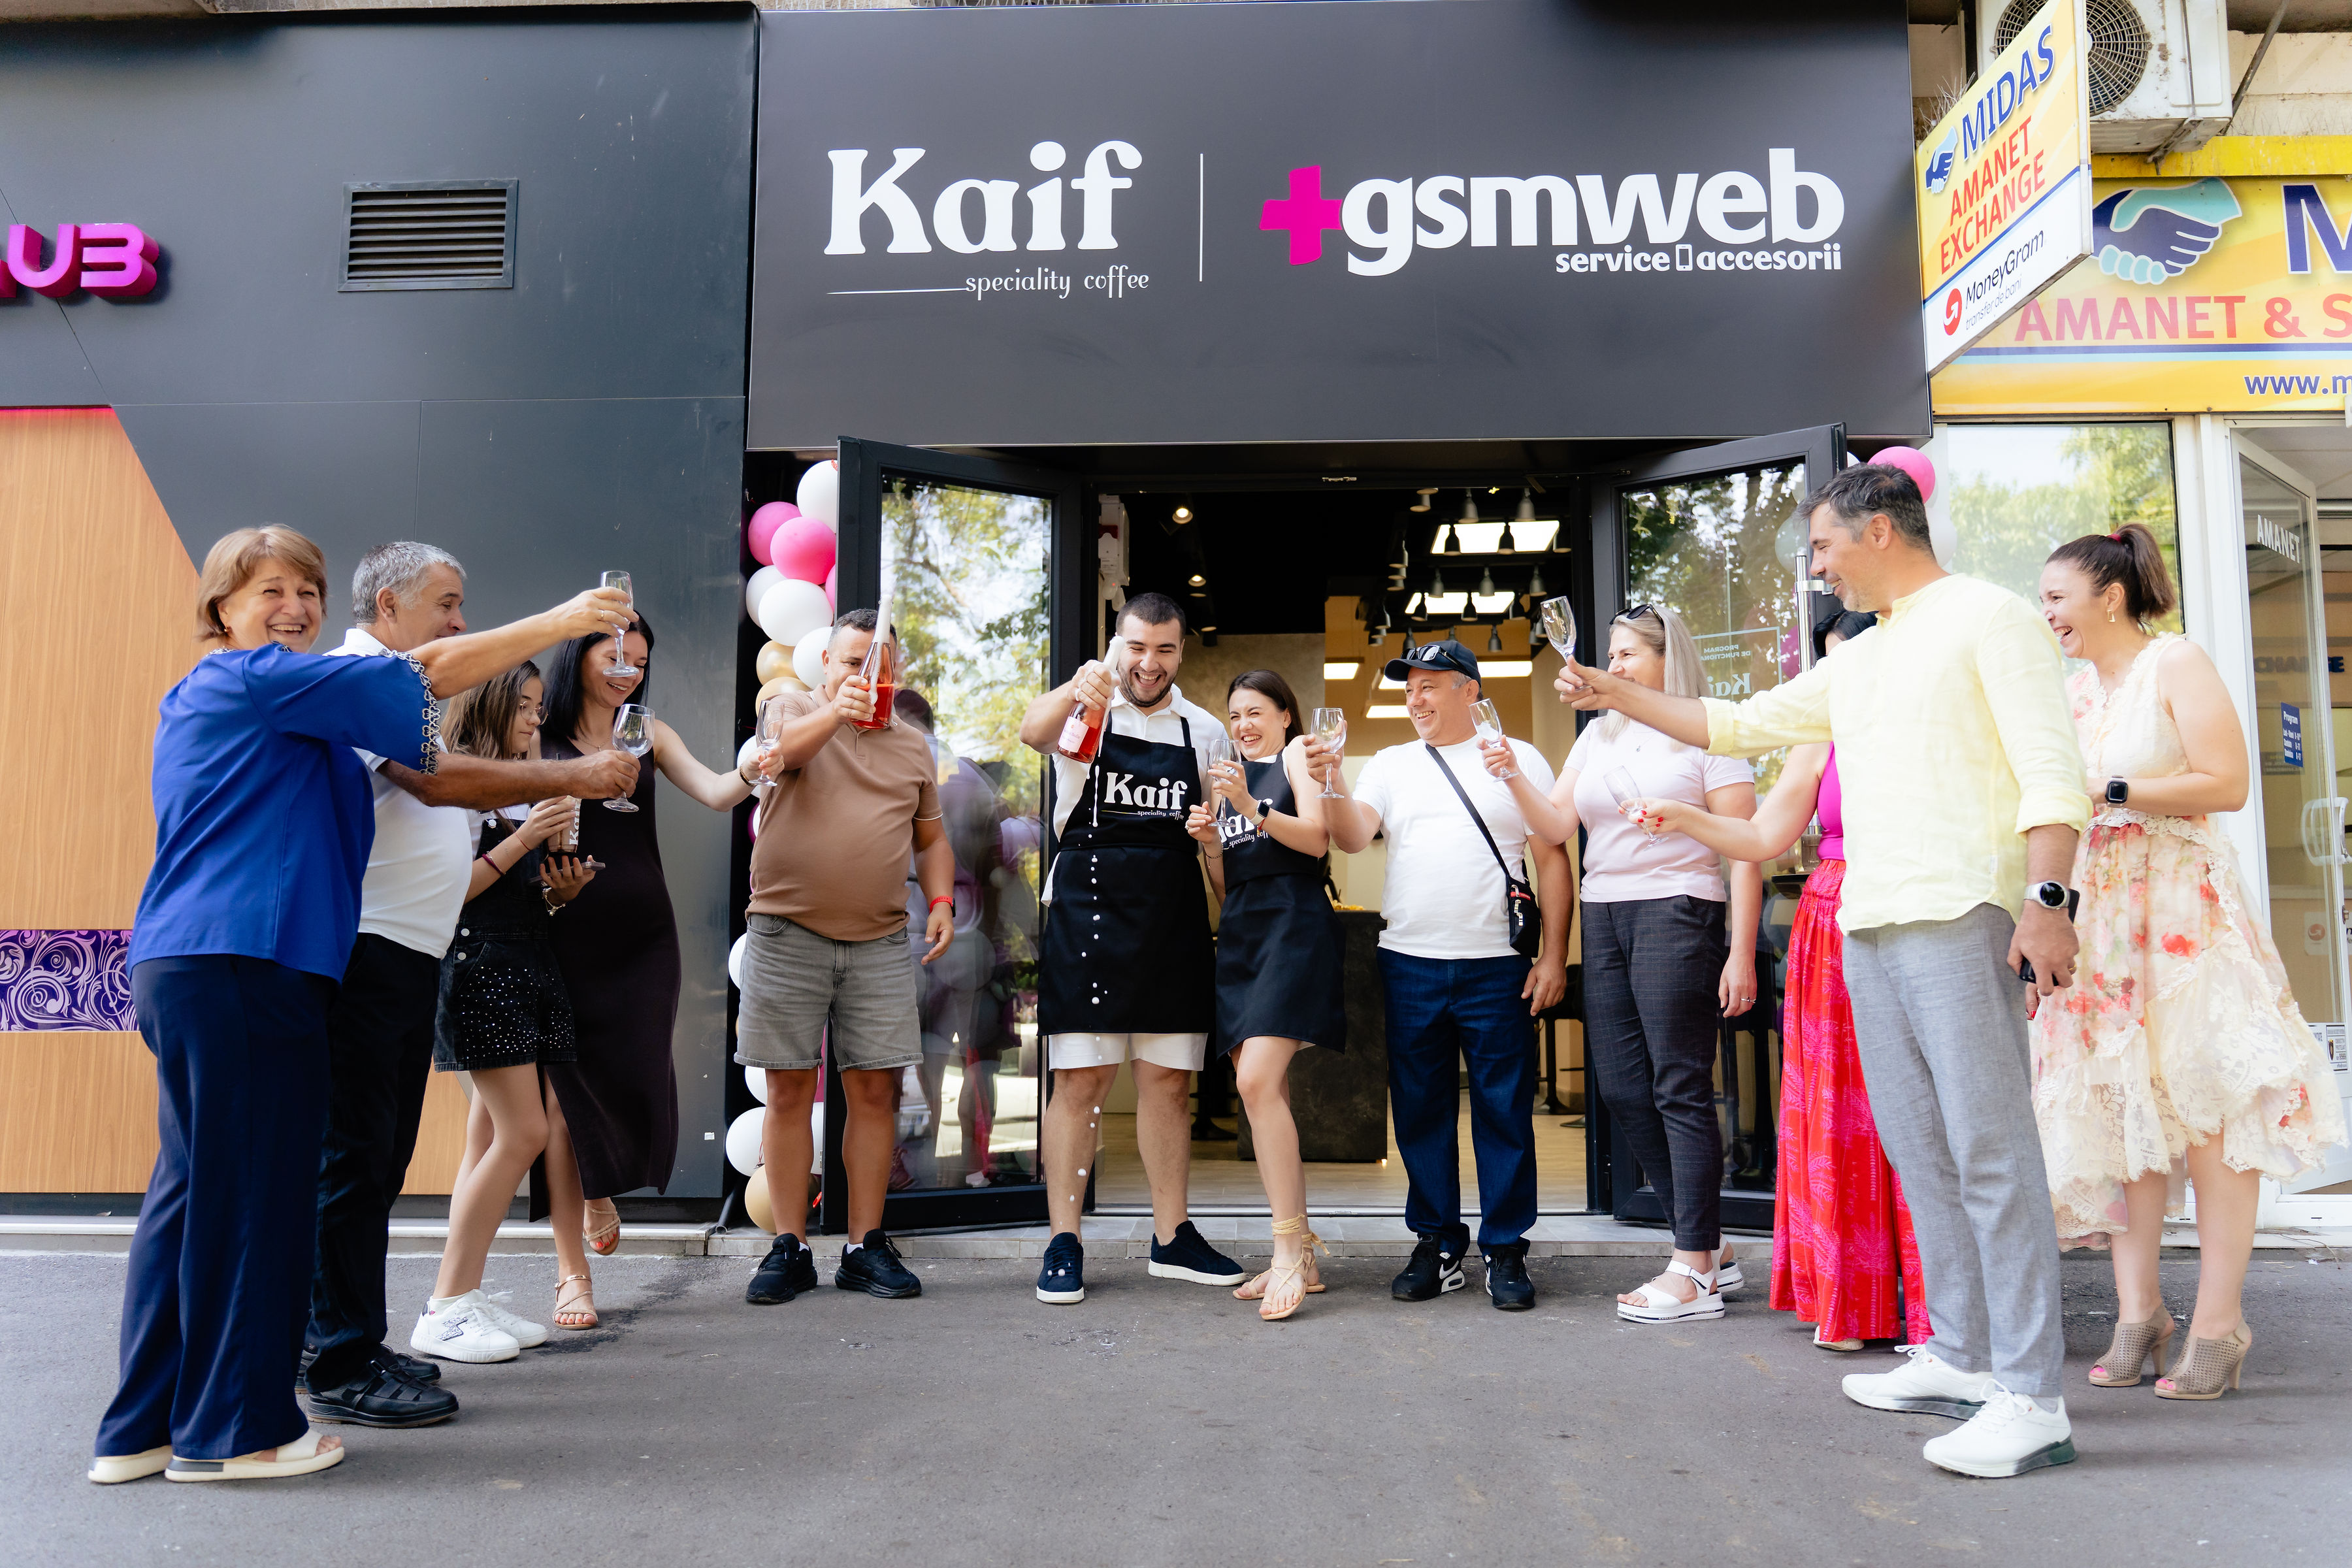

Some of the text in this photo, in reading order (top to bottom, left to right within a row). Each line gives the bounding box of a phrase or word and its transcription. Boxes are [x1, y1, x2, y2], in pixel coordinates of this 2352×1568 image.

[1961, 24, 2055, 162] MIDAS
[825, 140, 1143, 255] Kaif
[1950, 116, 2033, 226] AMANET
[1940, 149, 2046, 275] EXCHANGE
[0, 223, 159, 298] UB
[966, 265, 1149, 301] speciality coffee
[1556, 242, 1842, 273] service accesorii
[1966, 230, 2044, 310] MoneyGram
[1966, 273, 2023, 330] transfer de bani
[2014, 295, 2246, 342] AMANET
[2264, 297, 2308, 338] &
[2257, 514, 2300, 564] AMANET
[1103, 772, 1188, 810] Kaif
[1169, 810, 1184, 821] coffee
[1229, 833, 1255, 848] speciality
